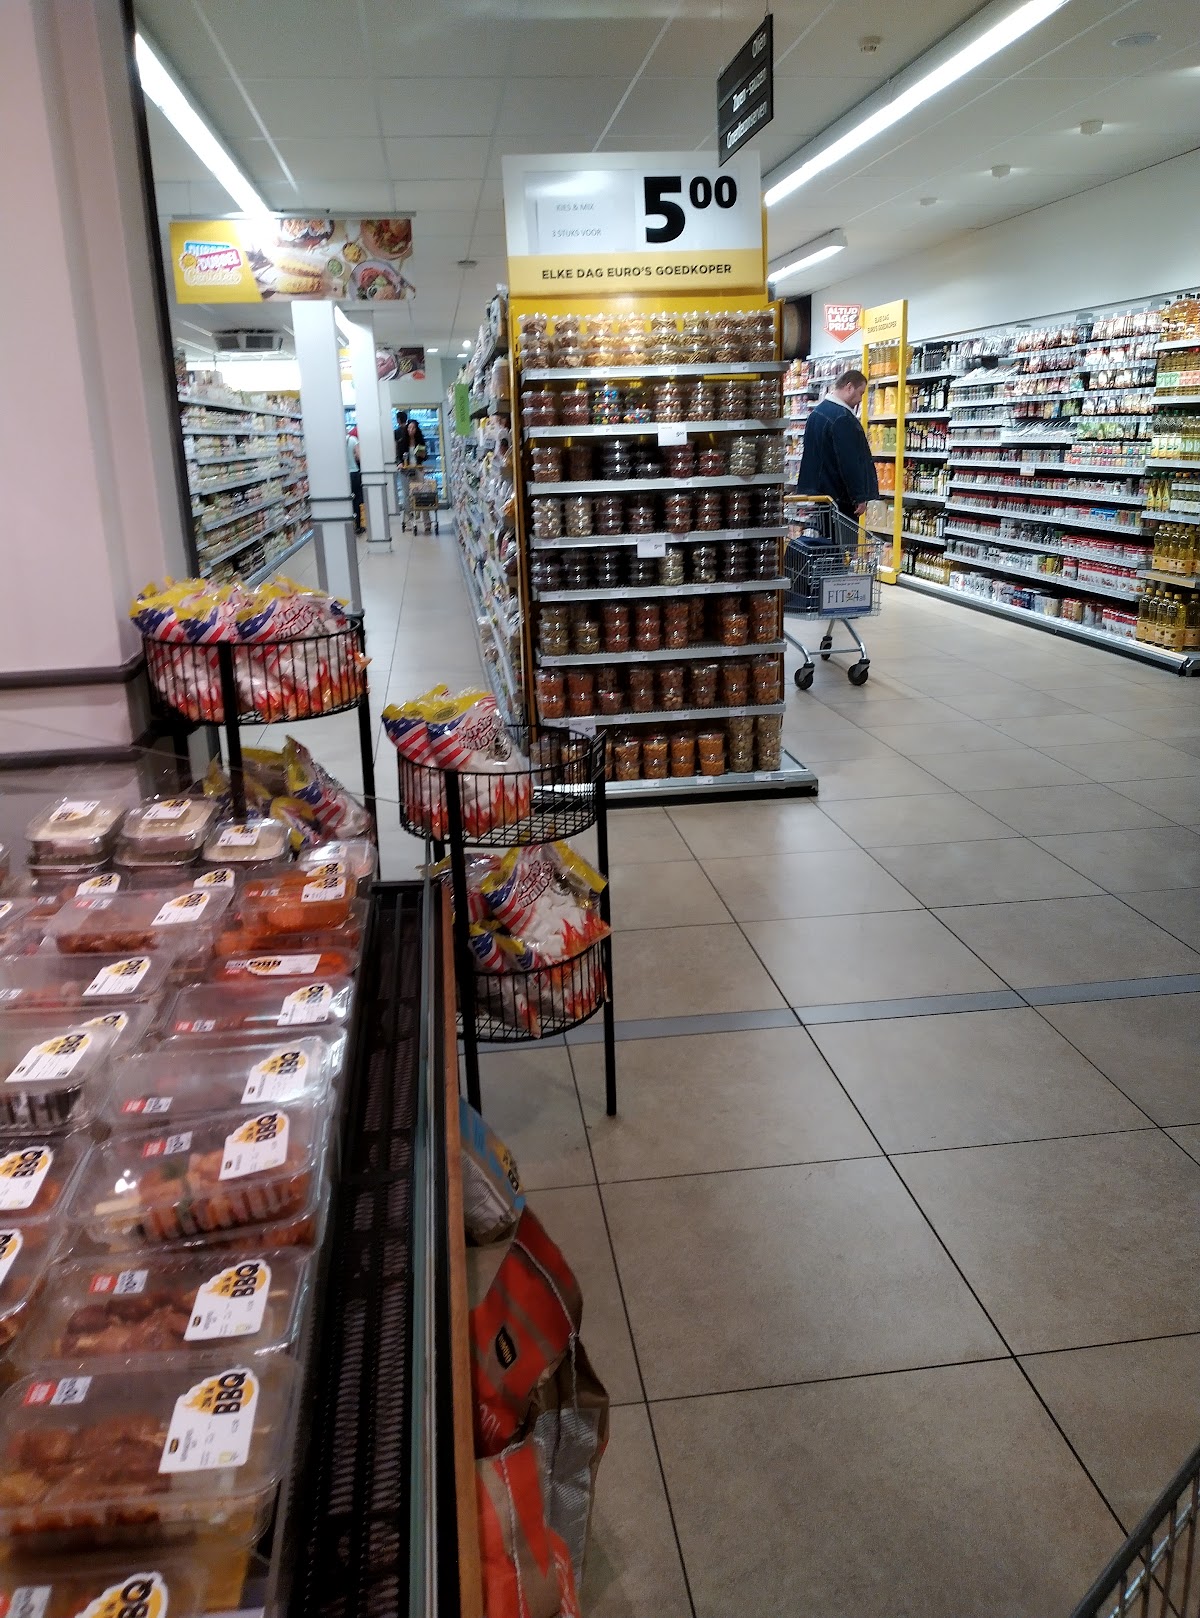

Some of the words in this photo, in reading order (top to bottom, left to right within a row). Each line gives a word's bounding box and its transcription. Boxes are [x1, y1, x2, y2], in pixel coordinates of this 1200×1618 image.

[581, 227, 602, 237] VOOR
[542, 269, 573, 280] ELKE
[576, 268, 604, 279] DAG
[606, 266, 652, 277] EURO'S
[655, 264, 732, 276] GOEDKOPER
[827, 307, 858, 315] ALTIJD
[827, 314, 858, 323] LAGE
[828, 322, 856, 331] PRIJS
[827, 589, 847, 603] FIT
[255, 1113, 277, 1143] BBQ
[230, 1263, 260, 1298] BBQ
[212, 1372, 247, 1415] BBQ
